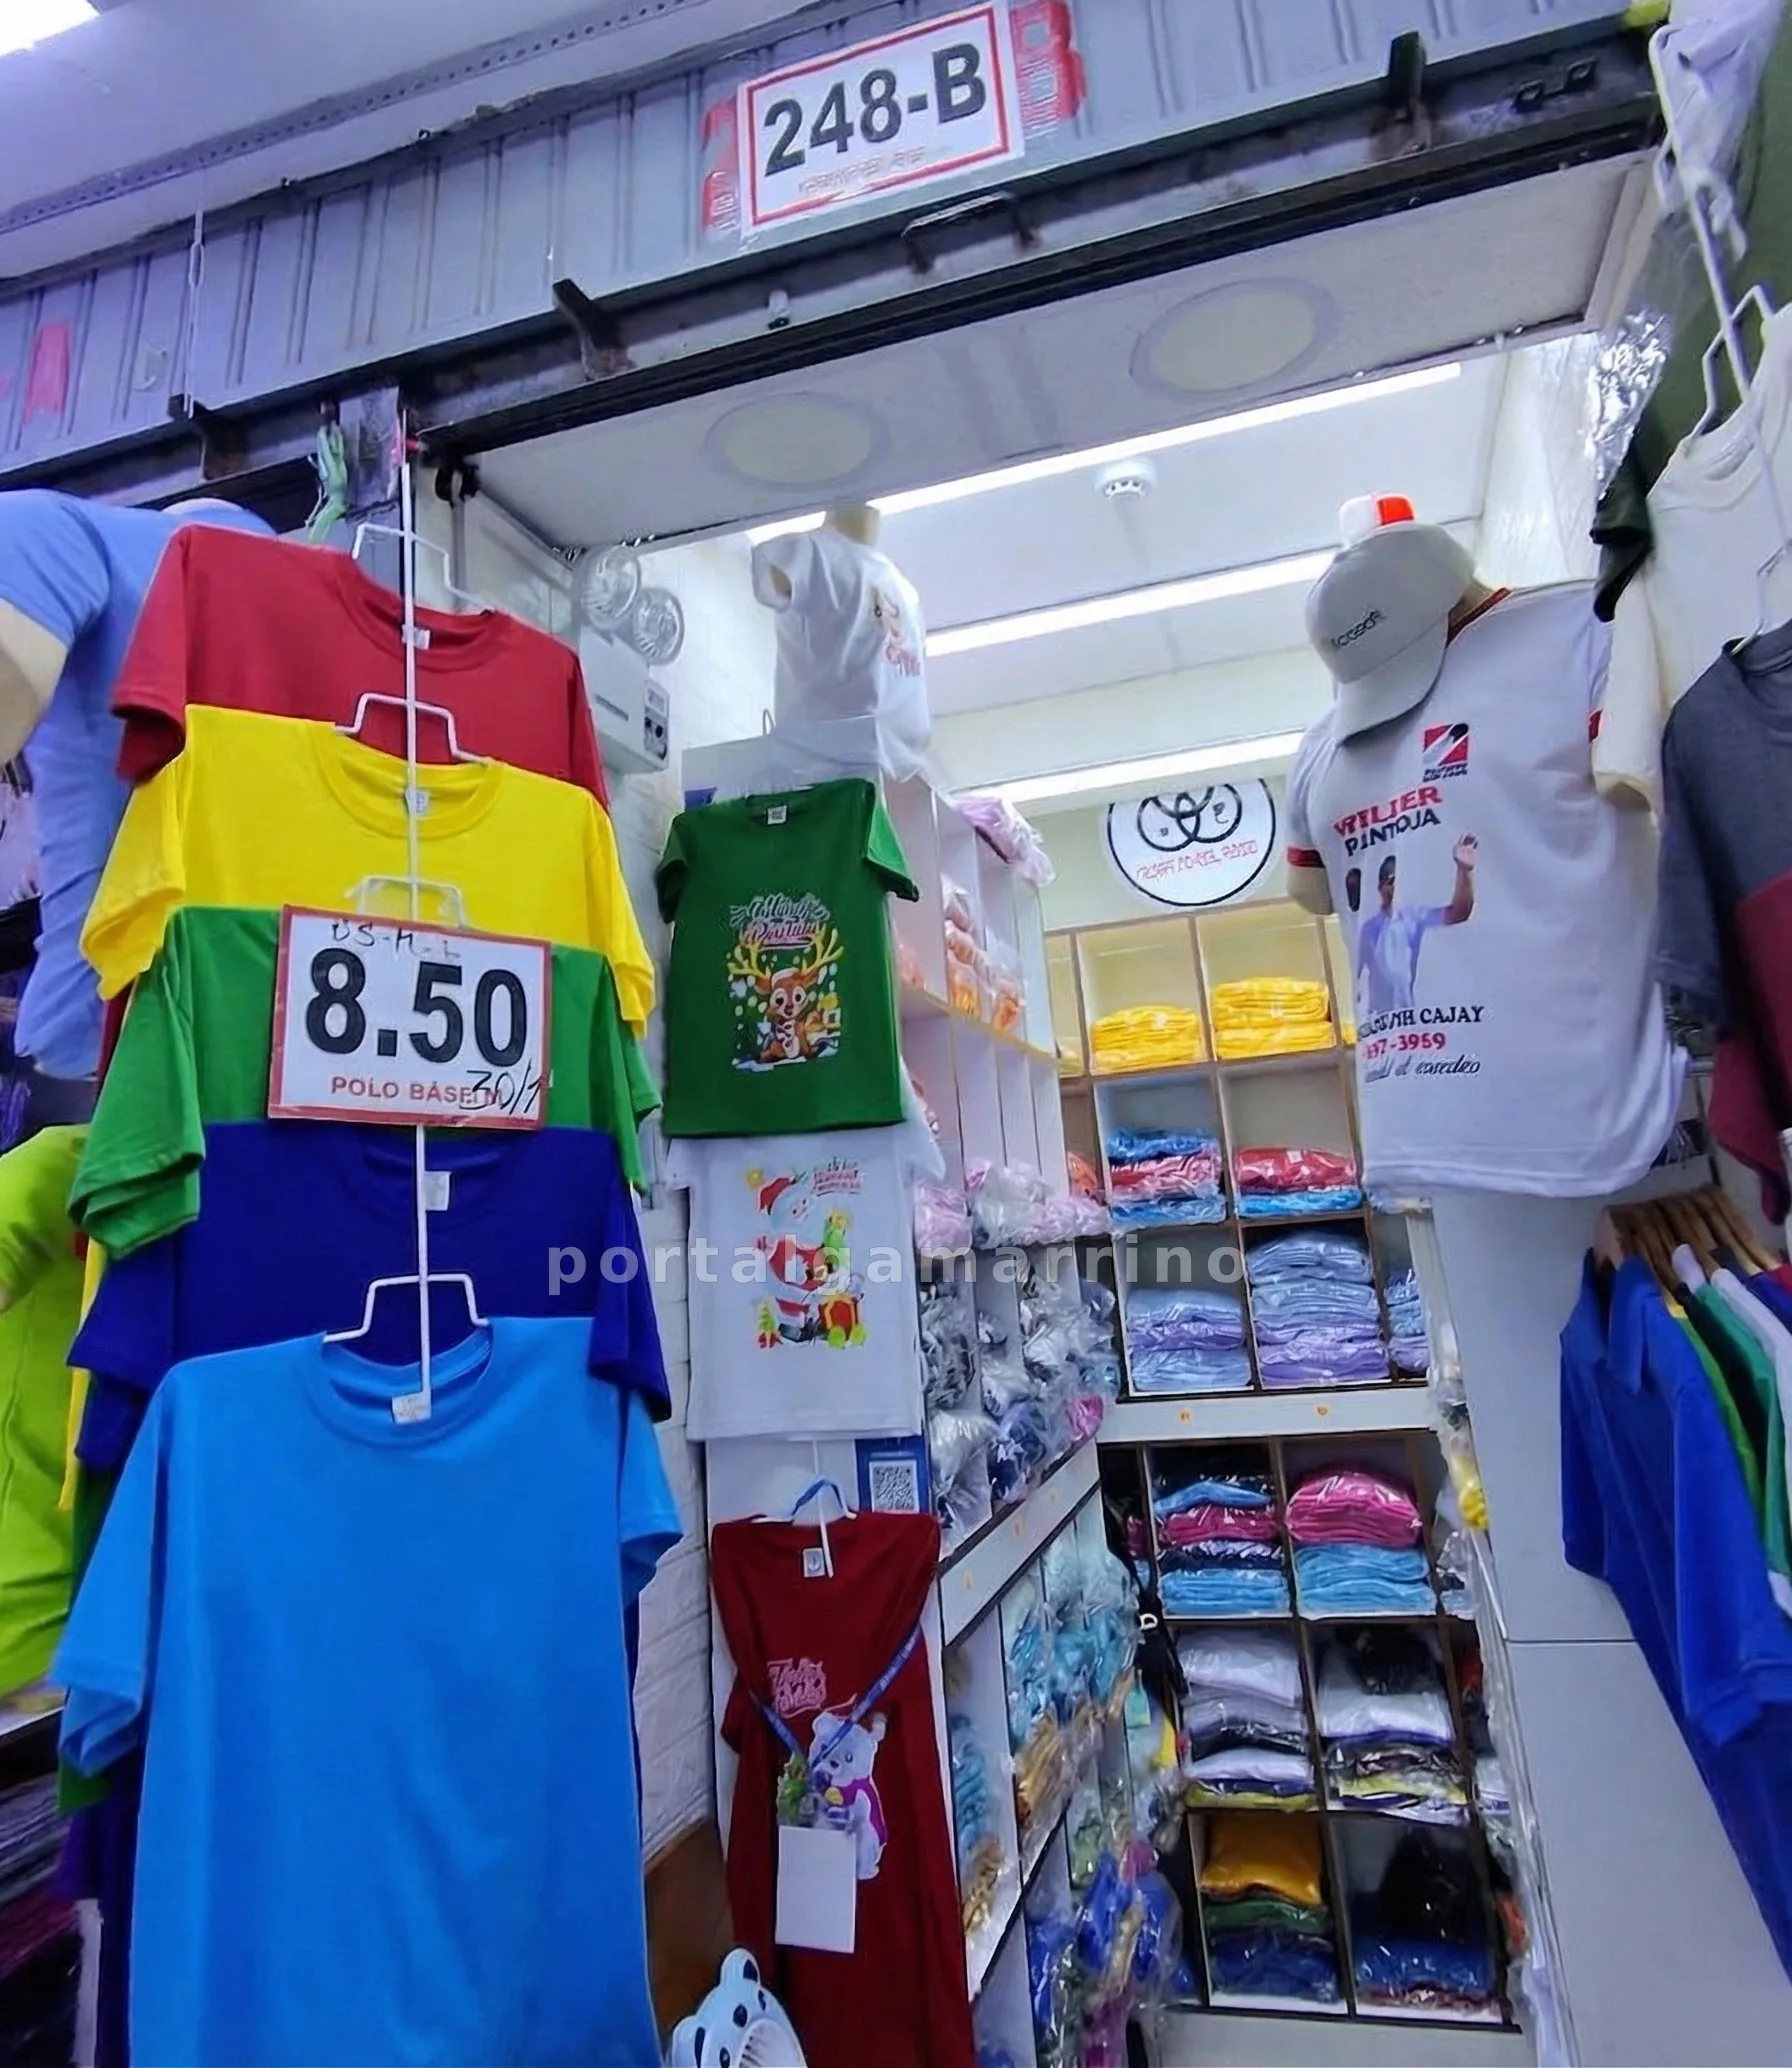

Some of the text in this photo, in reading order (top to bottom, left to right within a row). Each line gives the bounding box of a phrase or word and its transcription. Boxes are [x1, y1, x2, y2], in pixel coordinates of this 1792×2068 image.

[764, 43, 986, 176] 248-B
[306, 947, 527, 1067] 8.50
[1419, 1006, 1485, 1024] CAJAY
[331, 1076, 400, 1099] POLO
